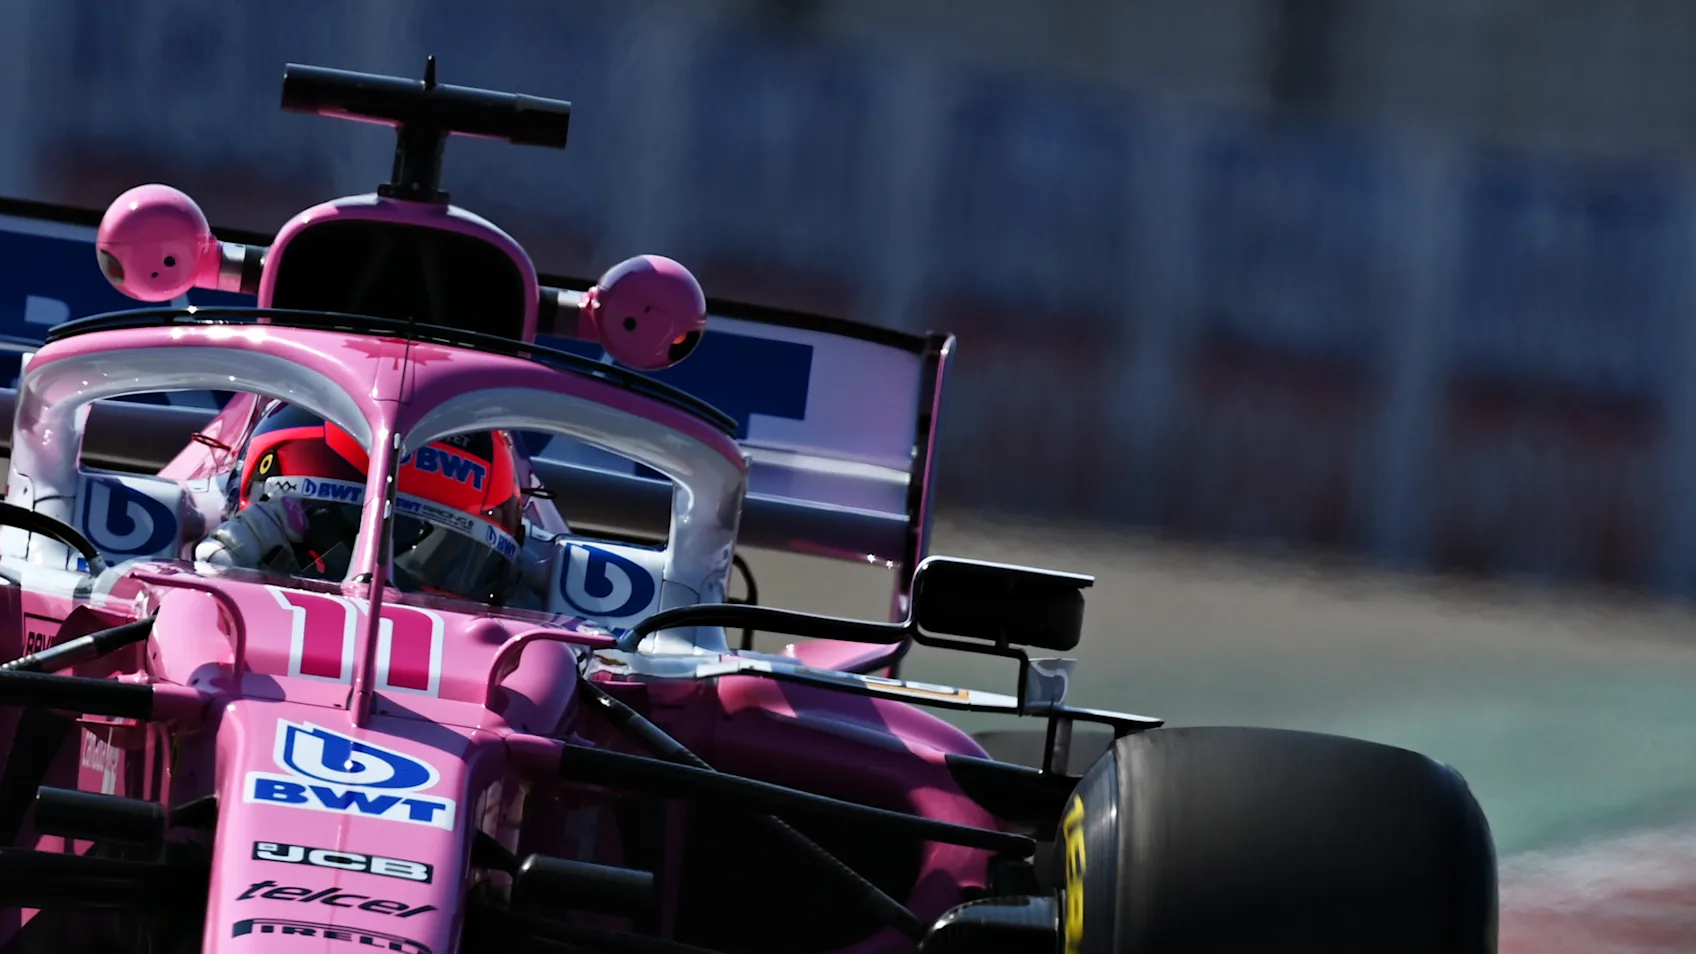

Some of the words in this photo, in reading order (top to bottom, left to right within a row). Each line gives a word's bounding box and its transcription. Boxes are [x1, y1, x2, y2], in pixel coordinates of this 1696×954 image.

[415, 447, 486, 490] BWT
[318, 482, 362, 502] BWT
[264, 584, 445, 698] 11
[253, 777, 447, 823] BWT
[256, 842, 429, 882] JCB
[235, 880, 439, 919] telcel
